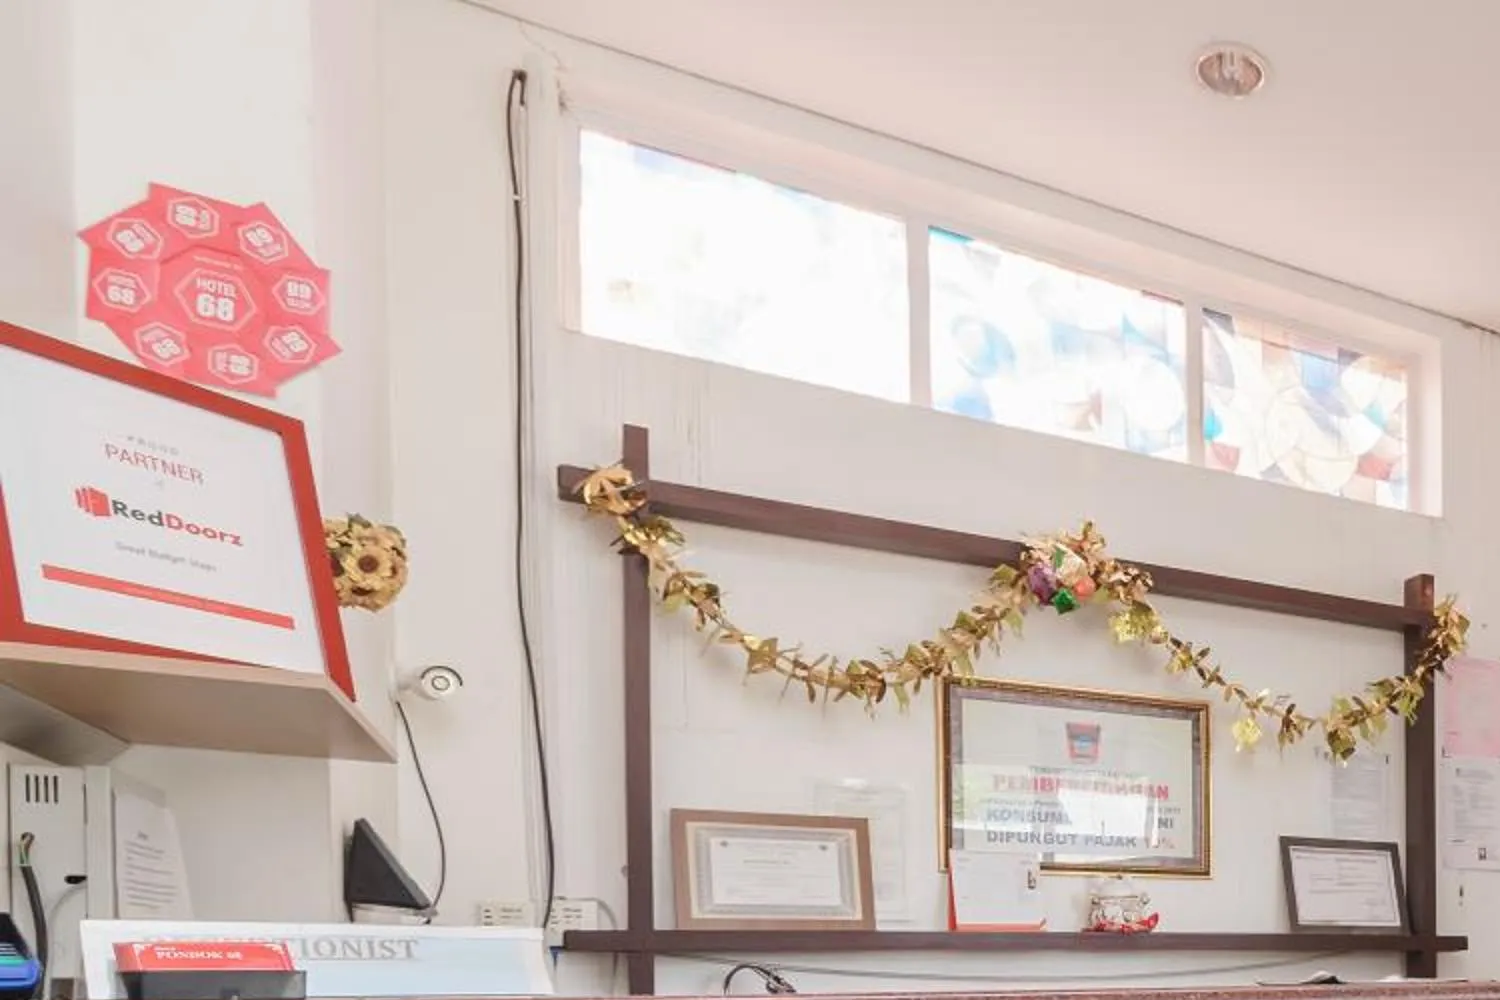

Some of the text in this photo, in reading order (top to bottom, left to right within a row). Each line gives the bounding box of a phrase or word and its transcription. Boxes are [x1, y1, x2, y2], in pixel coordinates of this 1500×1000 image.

[196, 278, 237, 298] HOTEL
[196, 295, 235, 322] 68
[104, 443, 204, 485] PARTNER
[111, 499, 244, 547] RedDoorz
